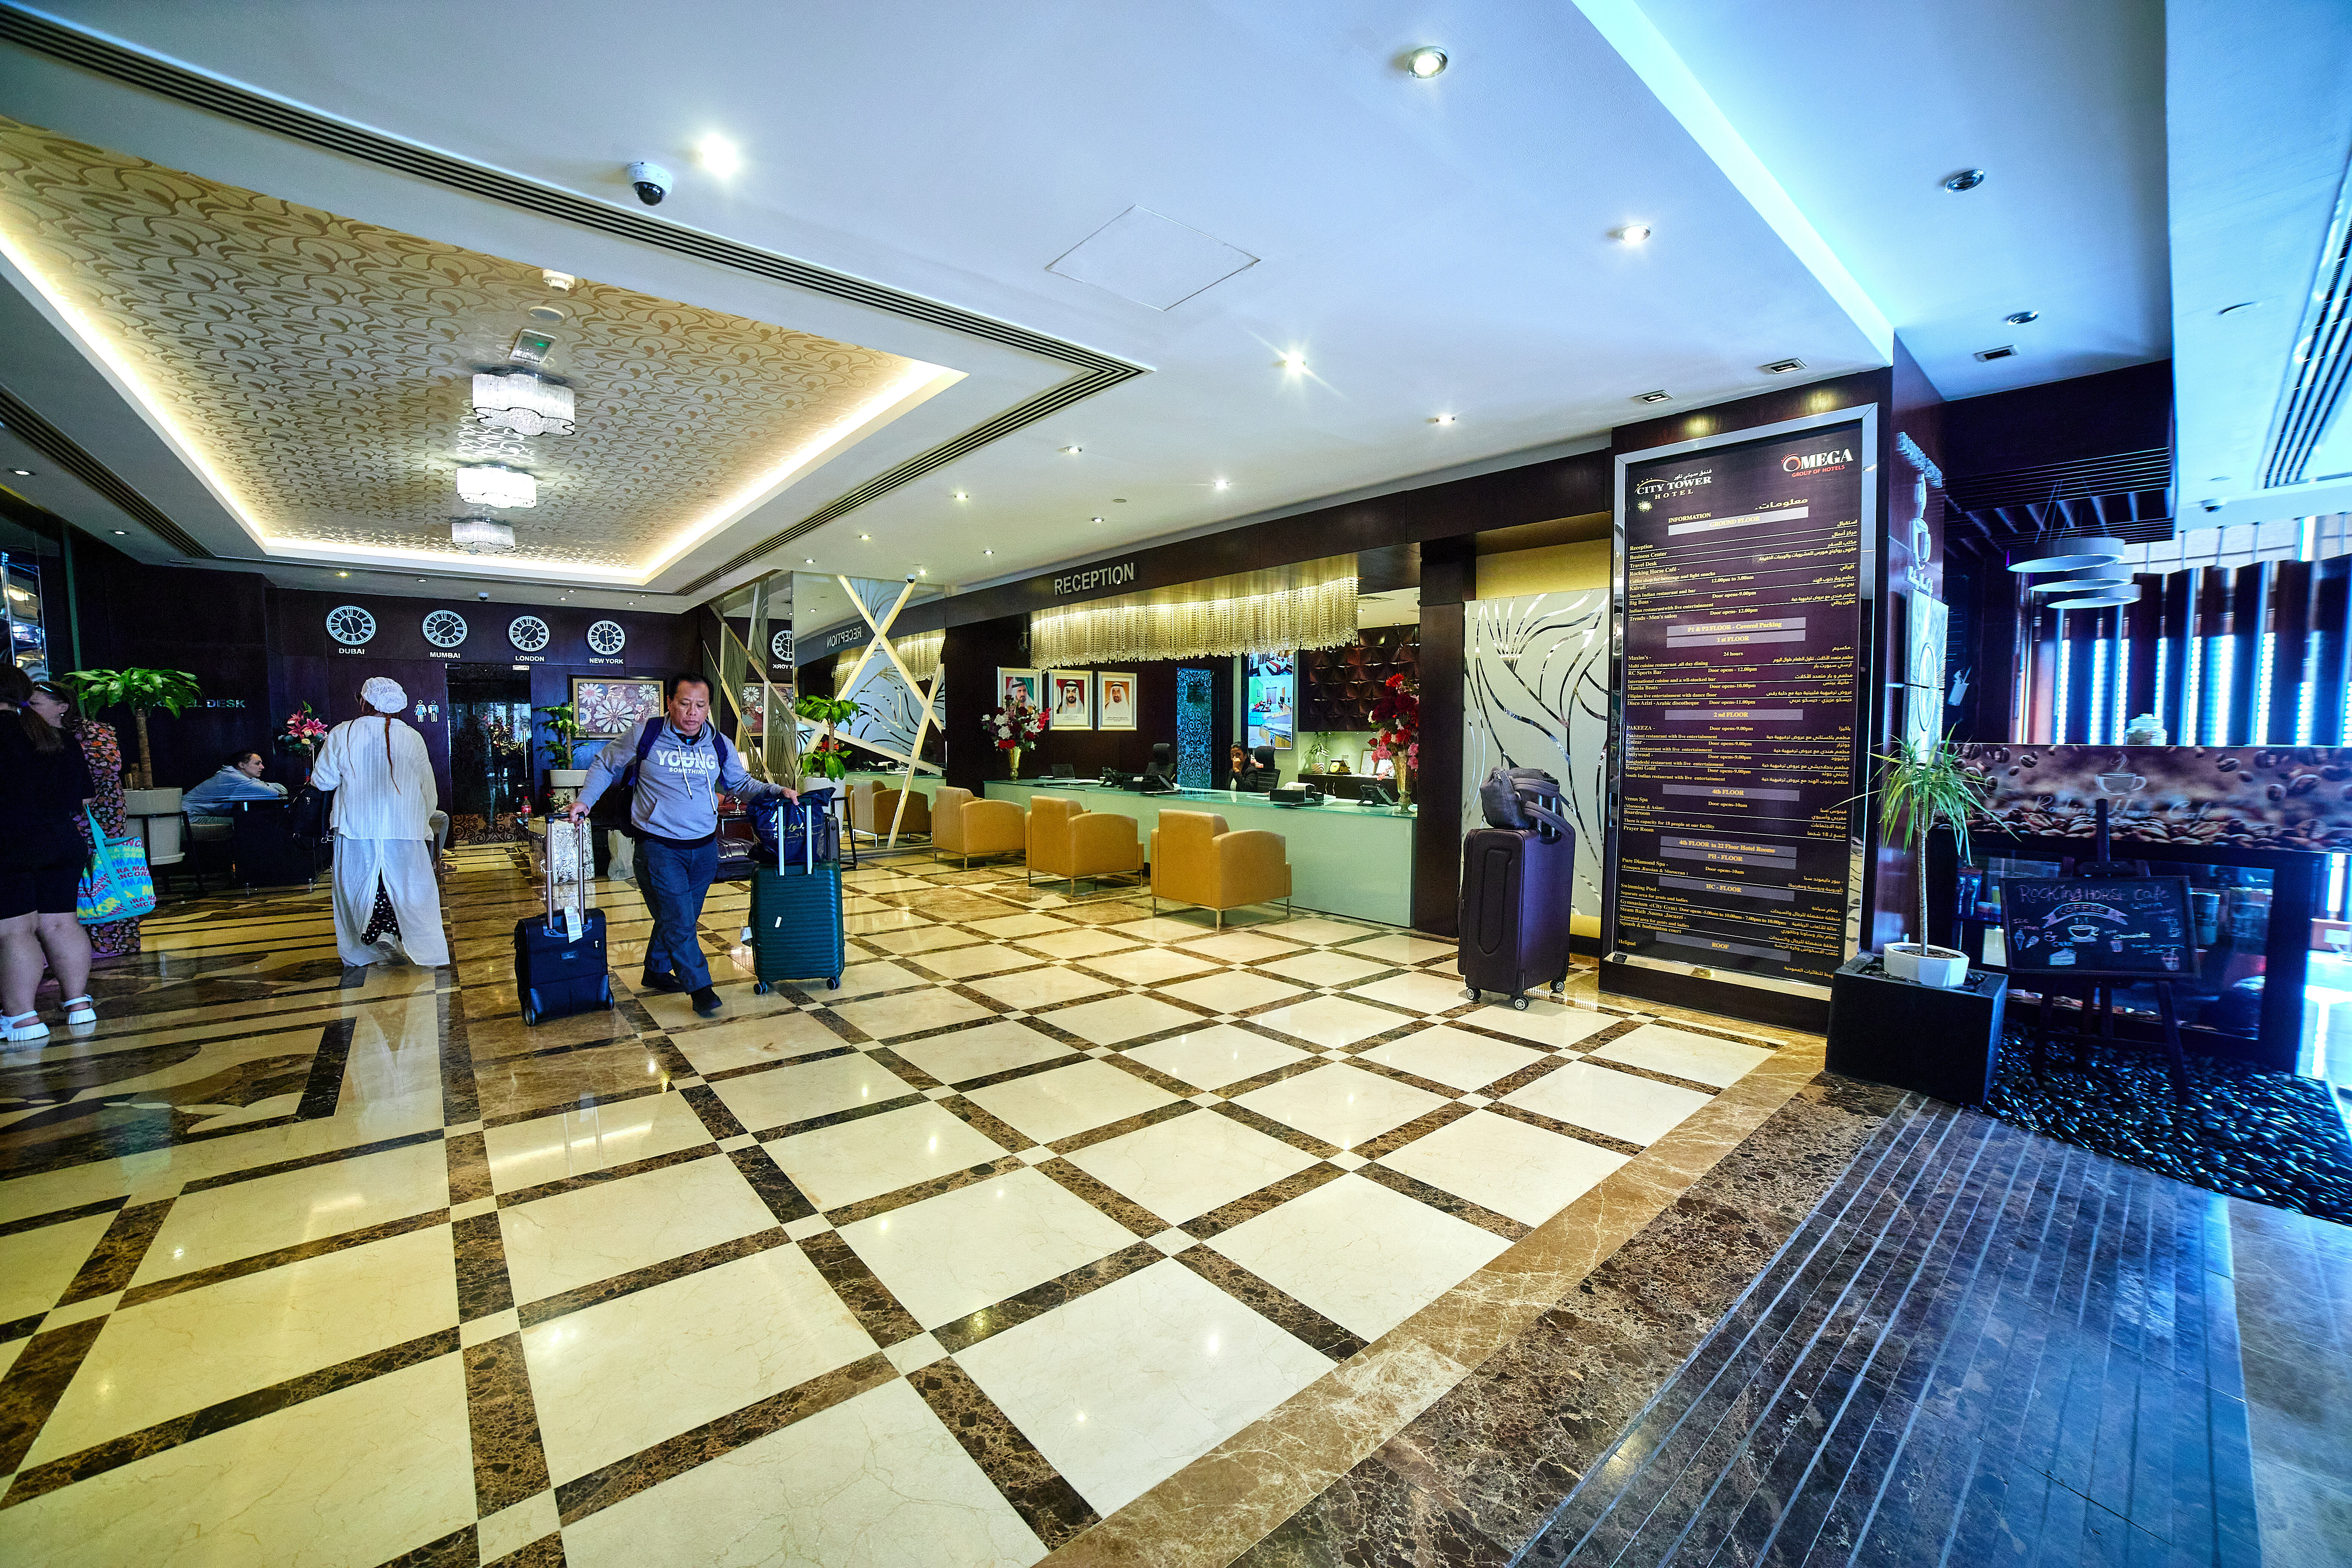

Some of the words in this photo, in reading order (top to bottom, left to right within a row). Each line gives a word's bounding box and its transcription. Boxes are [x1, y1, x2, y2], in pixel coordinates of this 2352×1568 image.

[1782, 449, 1853, 472] OMEGA
[1636, 484, 1664, 494] CITY
[1667, 476, 1712, 490] TOWER
[1655, 488, 1694, 499] HOTEL
[1668, 512, 1711, 523] INFORMATION
[1054, 562, 1135, 596] RECEPTION
[207, 699, 246, 708] DESK
[656, 750, 716, 770] YOUNG
[2059, 904, 2105, 914] COFFEE
